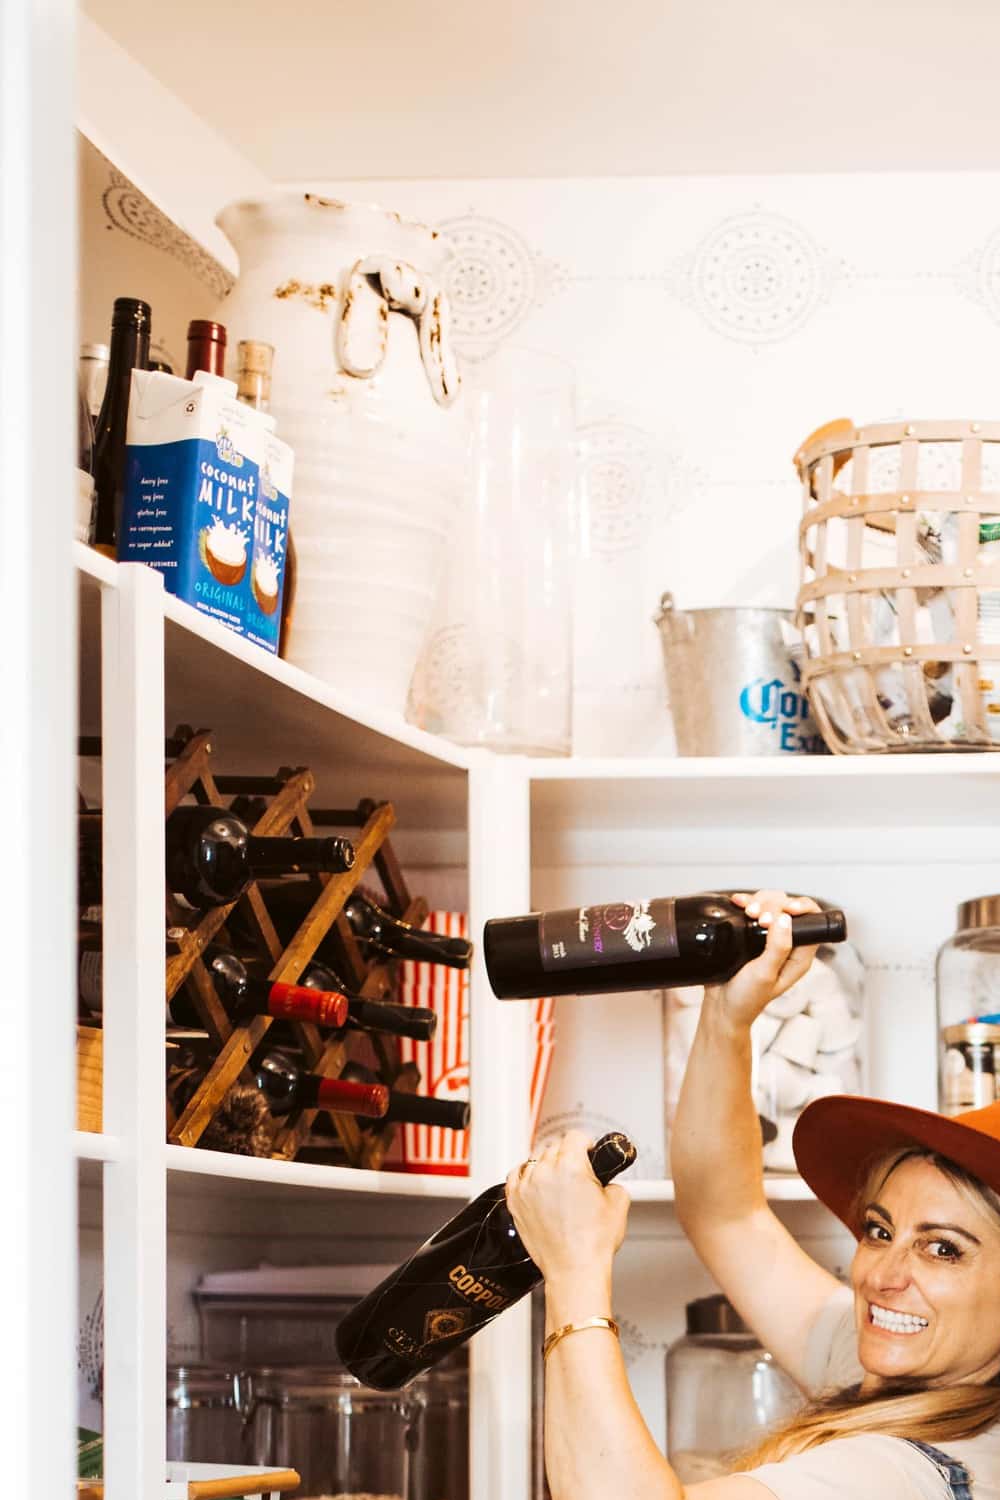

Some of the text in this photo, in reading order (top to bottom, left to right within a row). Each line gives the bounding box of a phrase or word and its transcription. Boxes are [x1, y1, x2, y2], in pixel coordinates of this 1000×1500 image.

[201, 461, 255, 496] coconut
[199, 478, 254, 522] MILK
[194, 582, 246, 611] ORIGINAL
